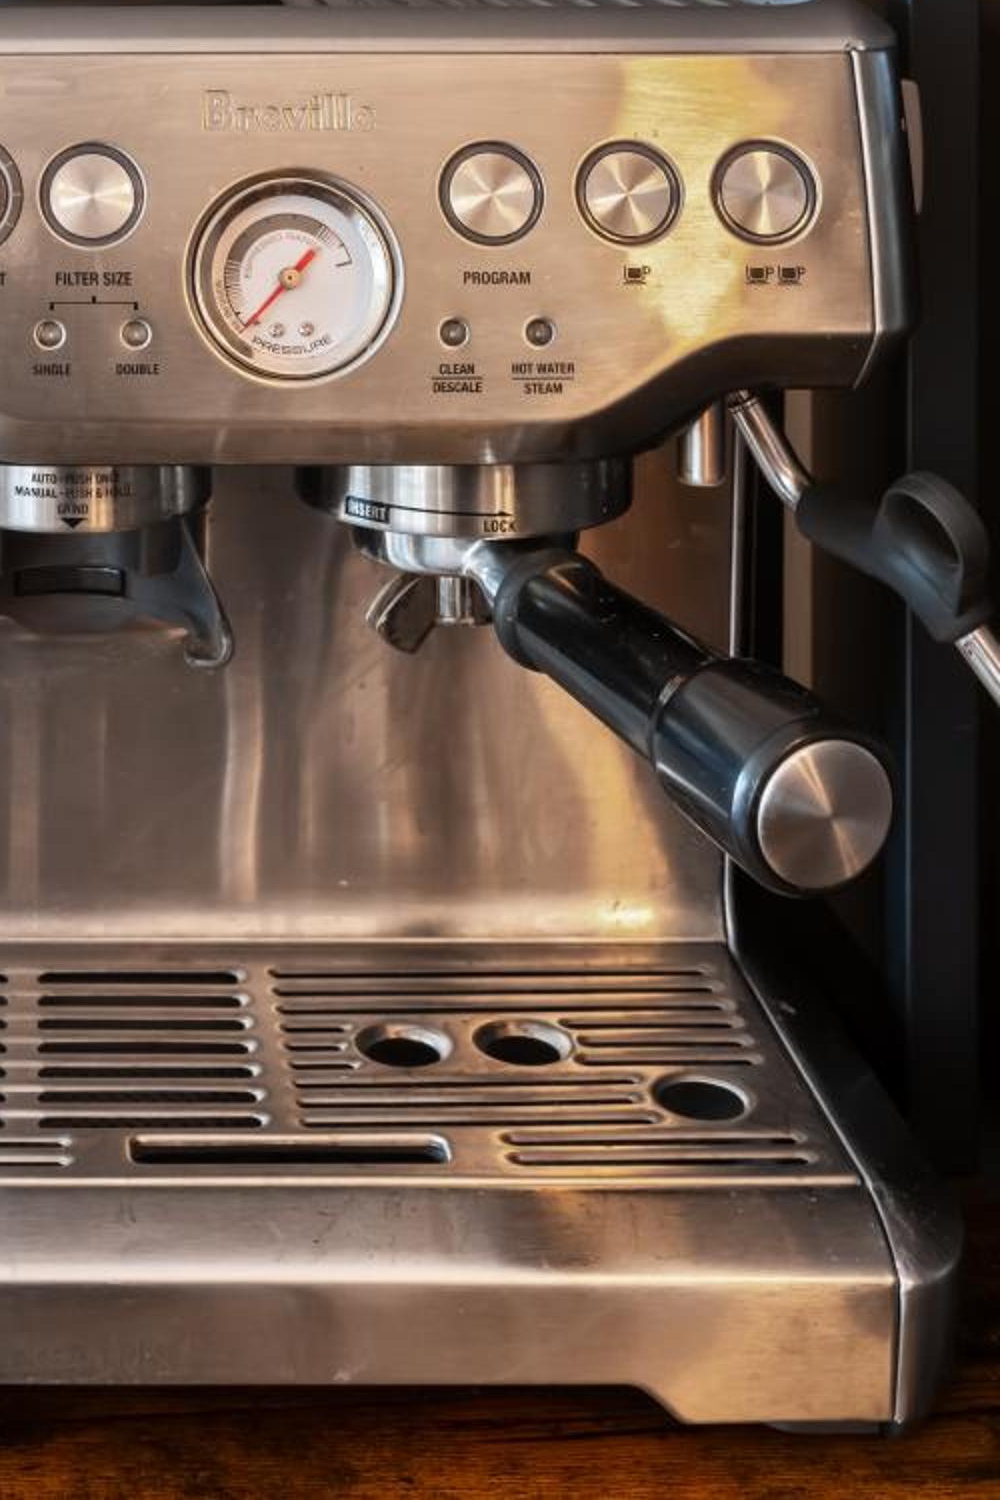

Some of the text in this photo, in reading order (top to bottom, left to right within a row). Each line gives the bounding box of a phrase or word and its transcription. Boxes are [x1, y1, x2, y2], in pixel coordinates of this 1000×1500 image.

[201, 87, 376, 133] Breville
[56, 272, 133, 286] FILTER SIZE
[463, 271, 531, 285] PROGRAM
[252, 335, 334, 357] PRESSURE
[32, 363, 70, 376] SINGLE
[115, 363, 160, 375] DOUBLE
[439, 363, 475, 375] CLEAN
[511, 362, 575, 375] HOT WATER
[432, 382, 483, 394] DESCALE
[523, 382, 563, 395] STEAM
[14, 486, 57, 499] MANUAL
[347, 499, 386, 520] INSERT
[484, 520, 517, 532] LOCK
